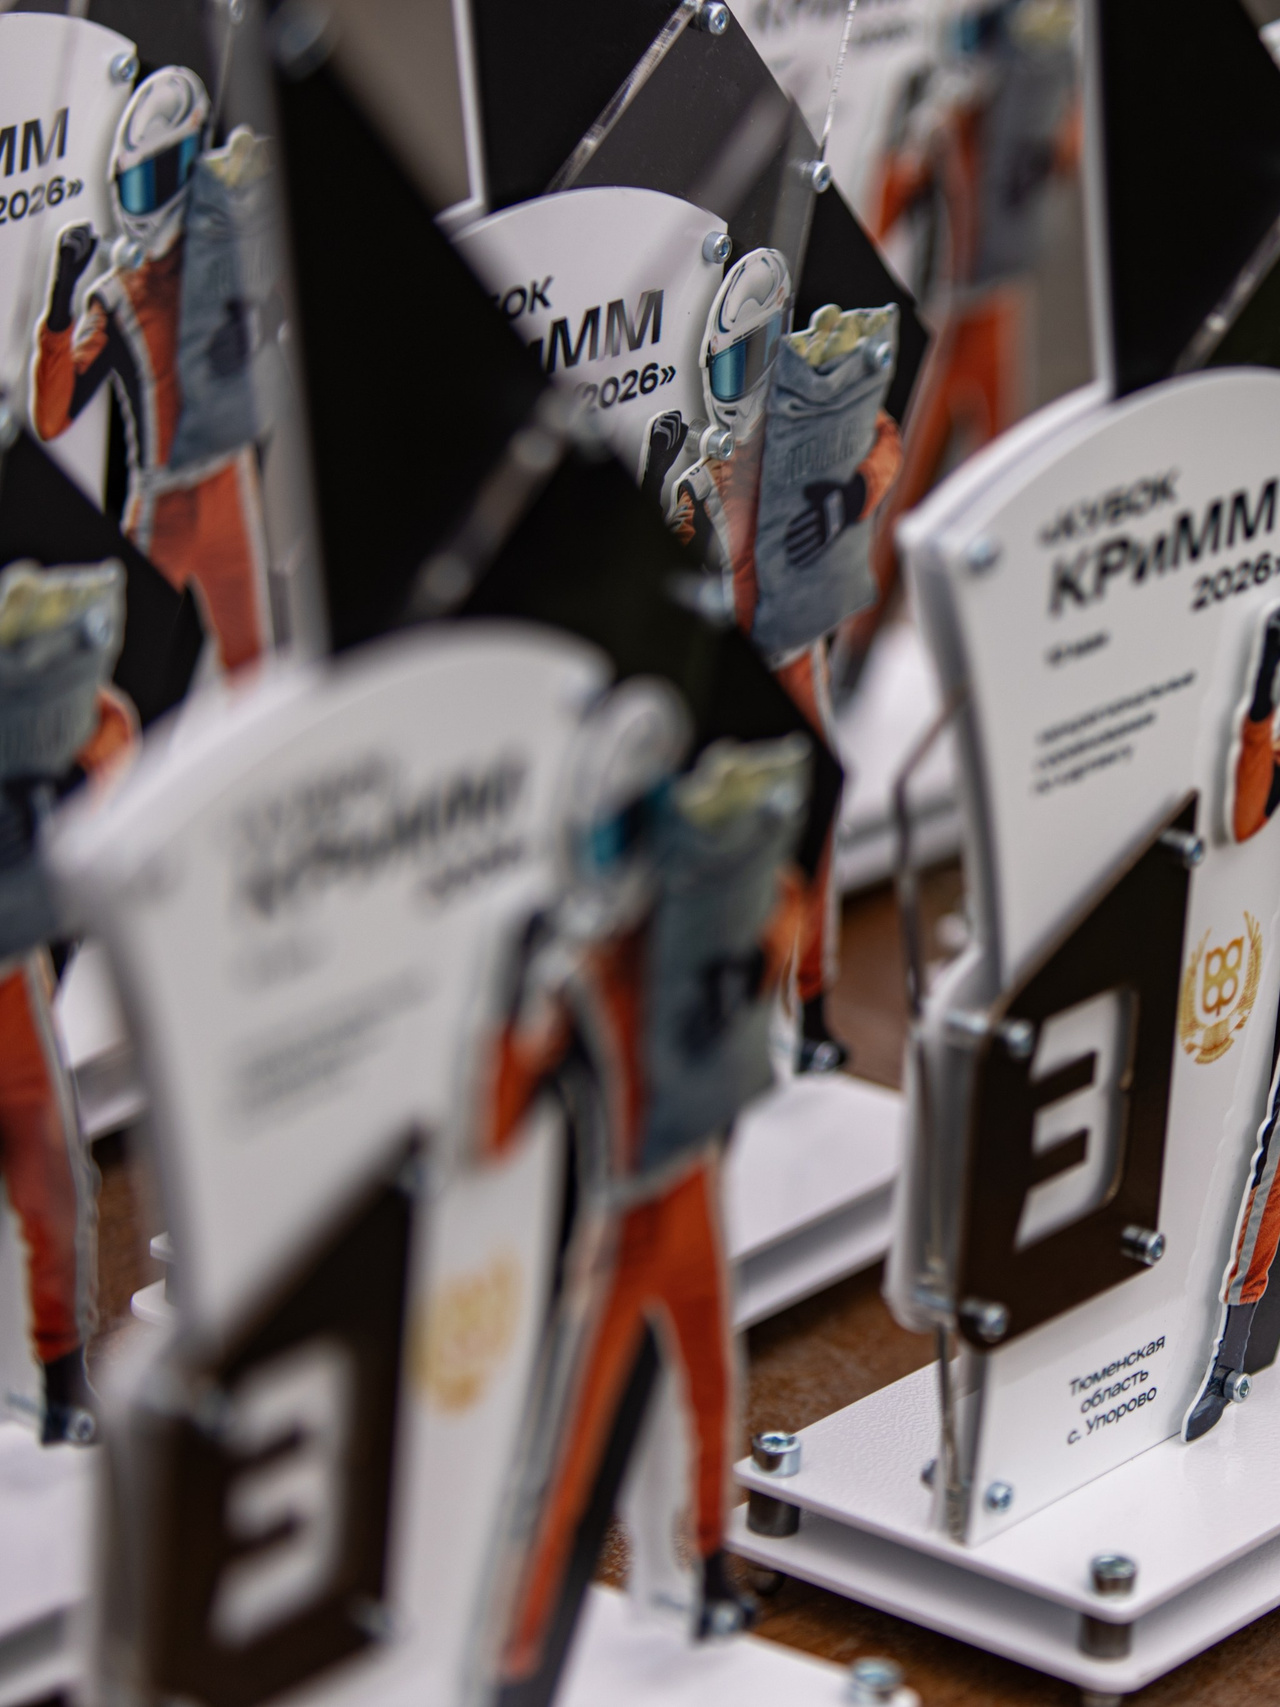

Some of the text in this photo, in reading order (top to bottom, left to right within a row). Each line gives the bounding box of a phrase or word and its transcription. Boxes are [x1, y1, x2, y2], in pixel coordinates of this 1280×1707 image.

[1048, 476, 1280, 618] КРиММ
[1069, 1335, 1166, 1396] Тюменская
[1080, 1369, 1149, 1414] область
[1066, 1386, 1158, 1446] с. Упорово
